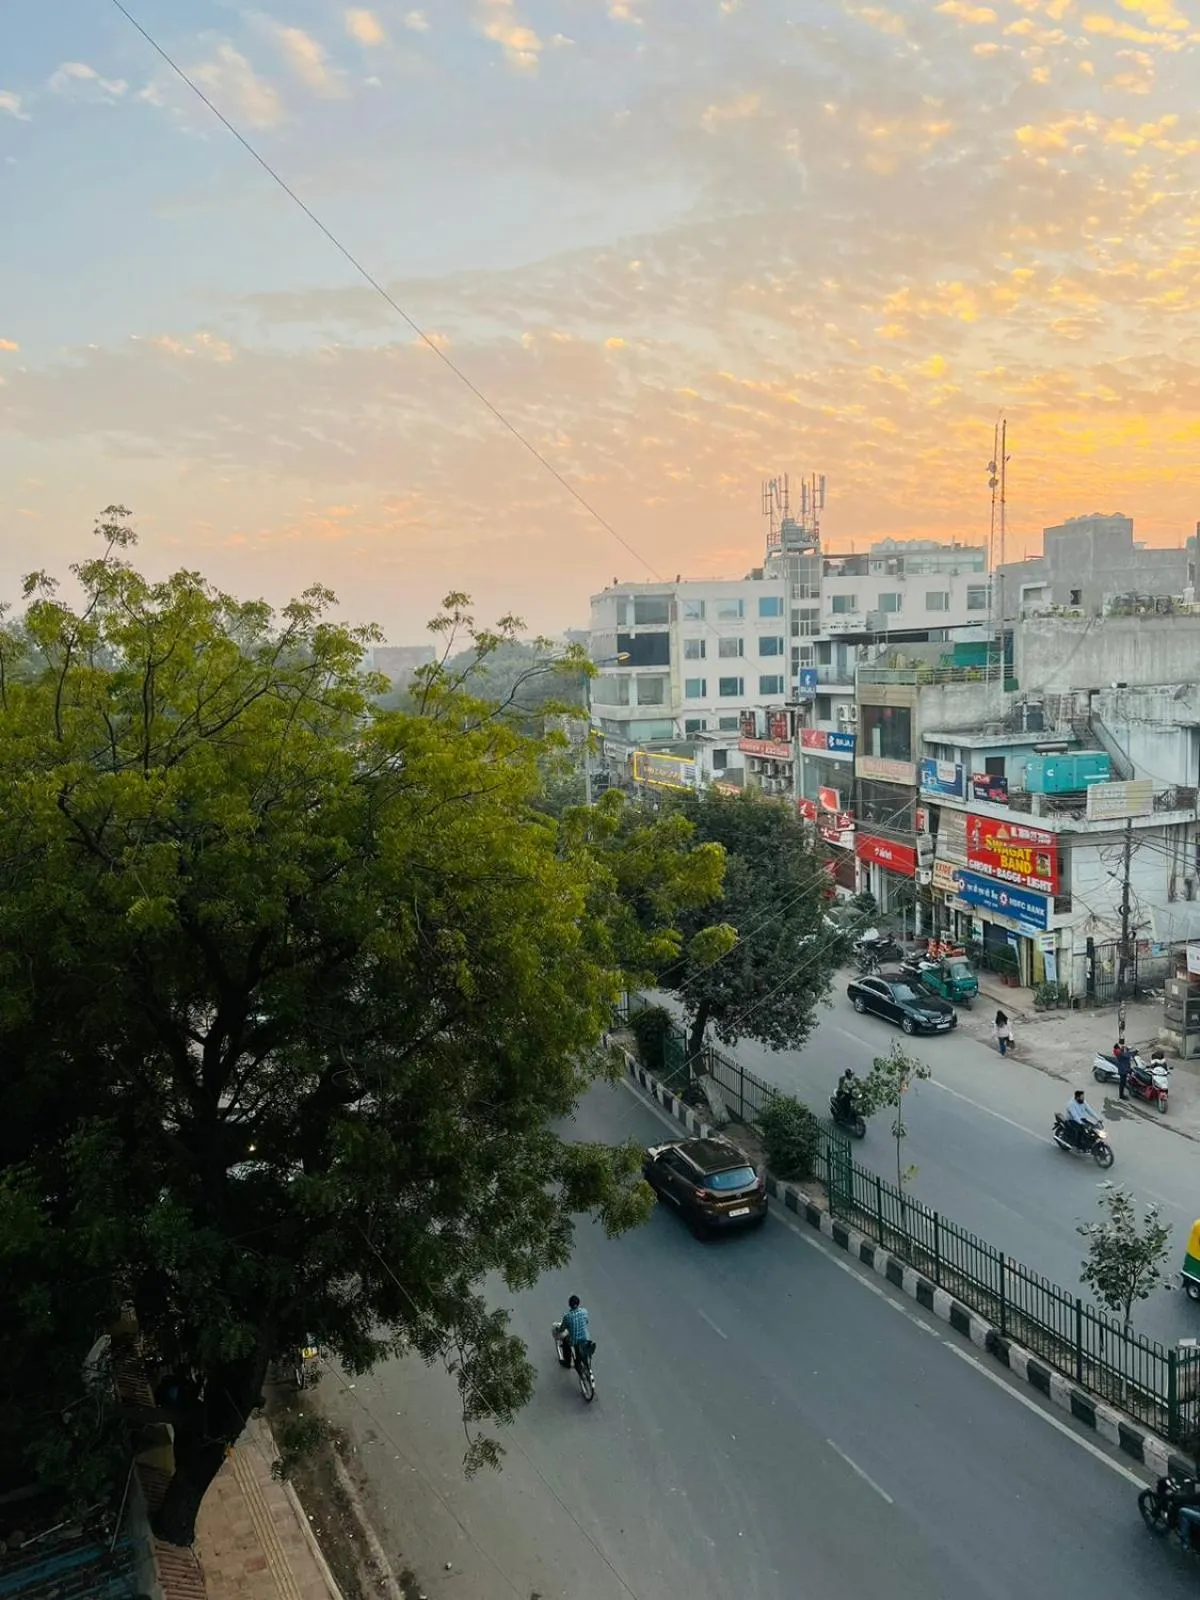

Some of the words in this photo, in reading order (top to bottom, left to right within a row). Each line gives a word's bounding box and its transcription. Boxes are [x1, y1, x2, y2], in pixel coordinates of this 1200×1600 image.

[835, 736, 854, 748] BAJAJ
[984, 834, 1033, 861] SWAGAT
[1000, 855, 1033, 874] BAND
[1026, 903, 1045, 916] BANK
